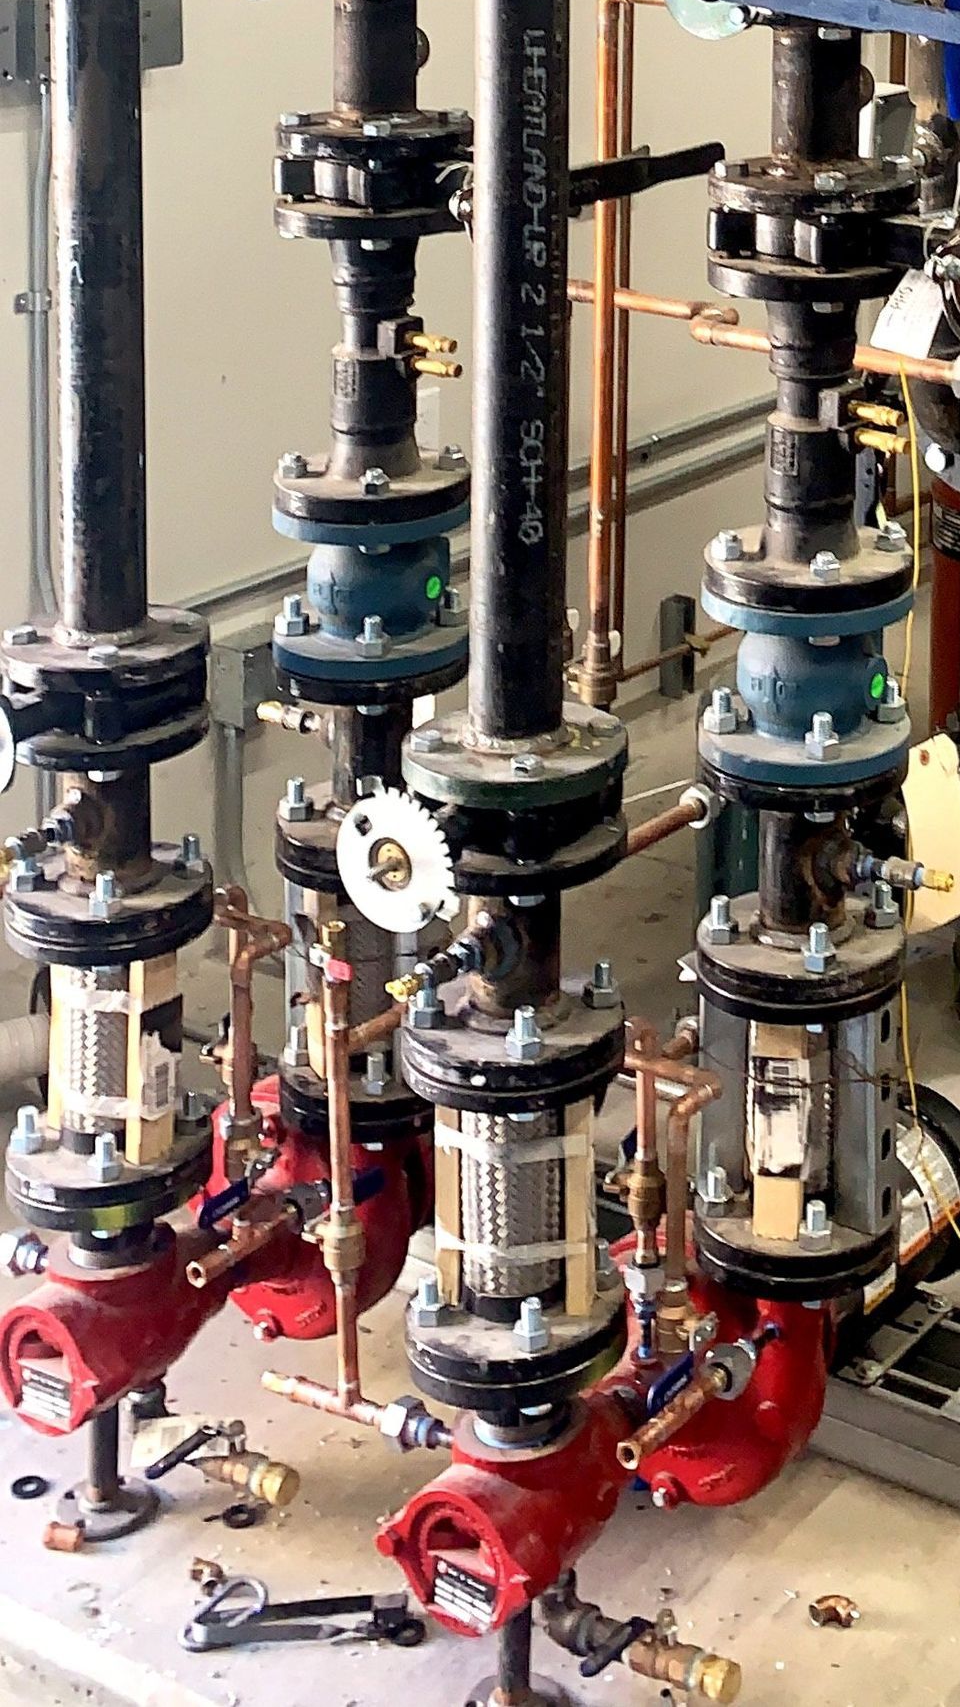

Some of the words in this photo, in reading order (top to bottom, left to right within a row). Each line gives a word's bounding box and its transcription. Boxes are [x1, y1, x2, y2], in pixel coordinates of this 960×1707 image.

[520, 282, 546, 306] 2
[520, 322, 547, 398] 1/2"
[517, 419, 545, 546] SCH-40
